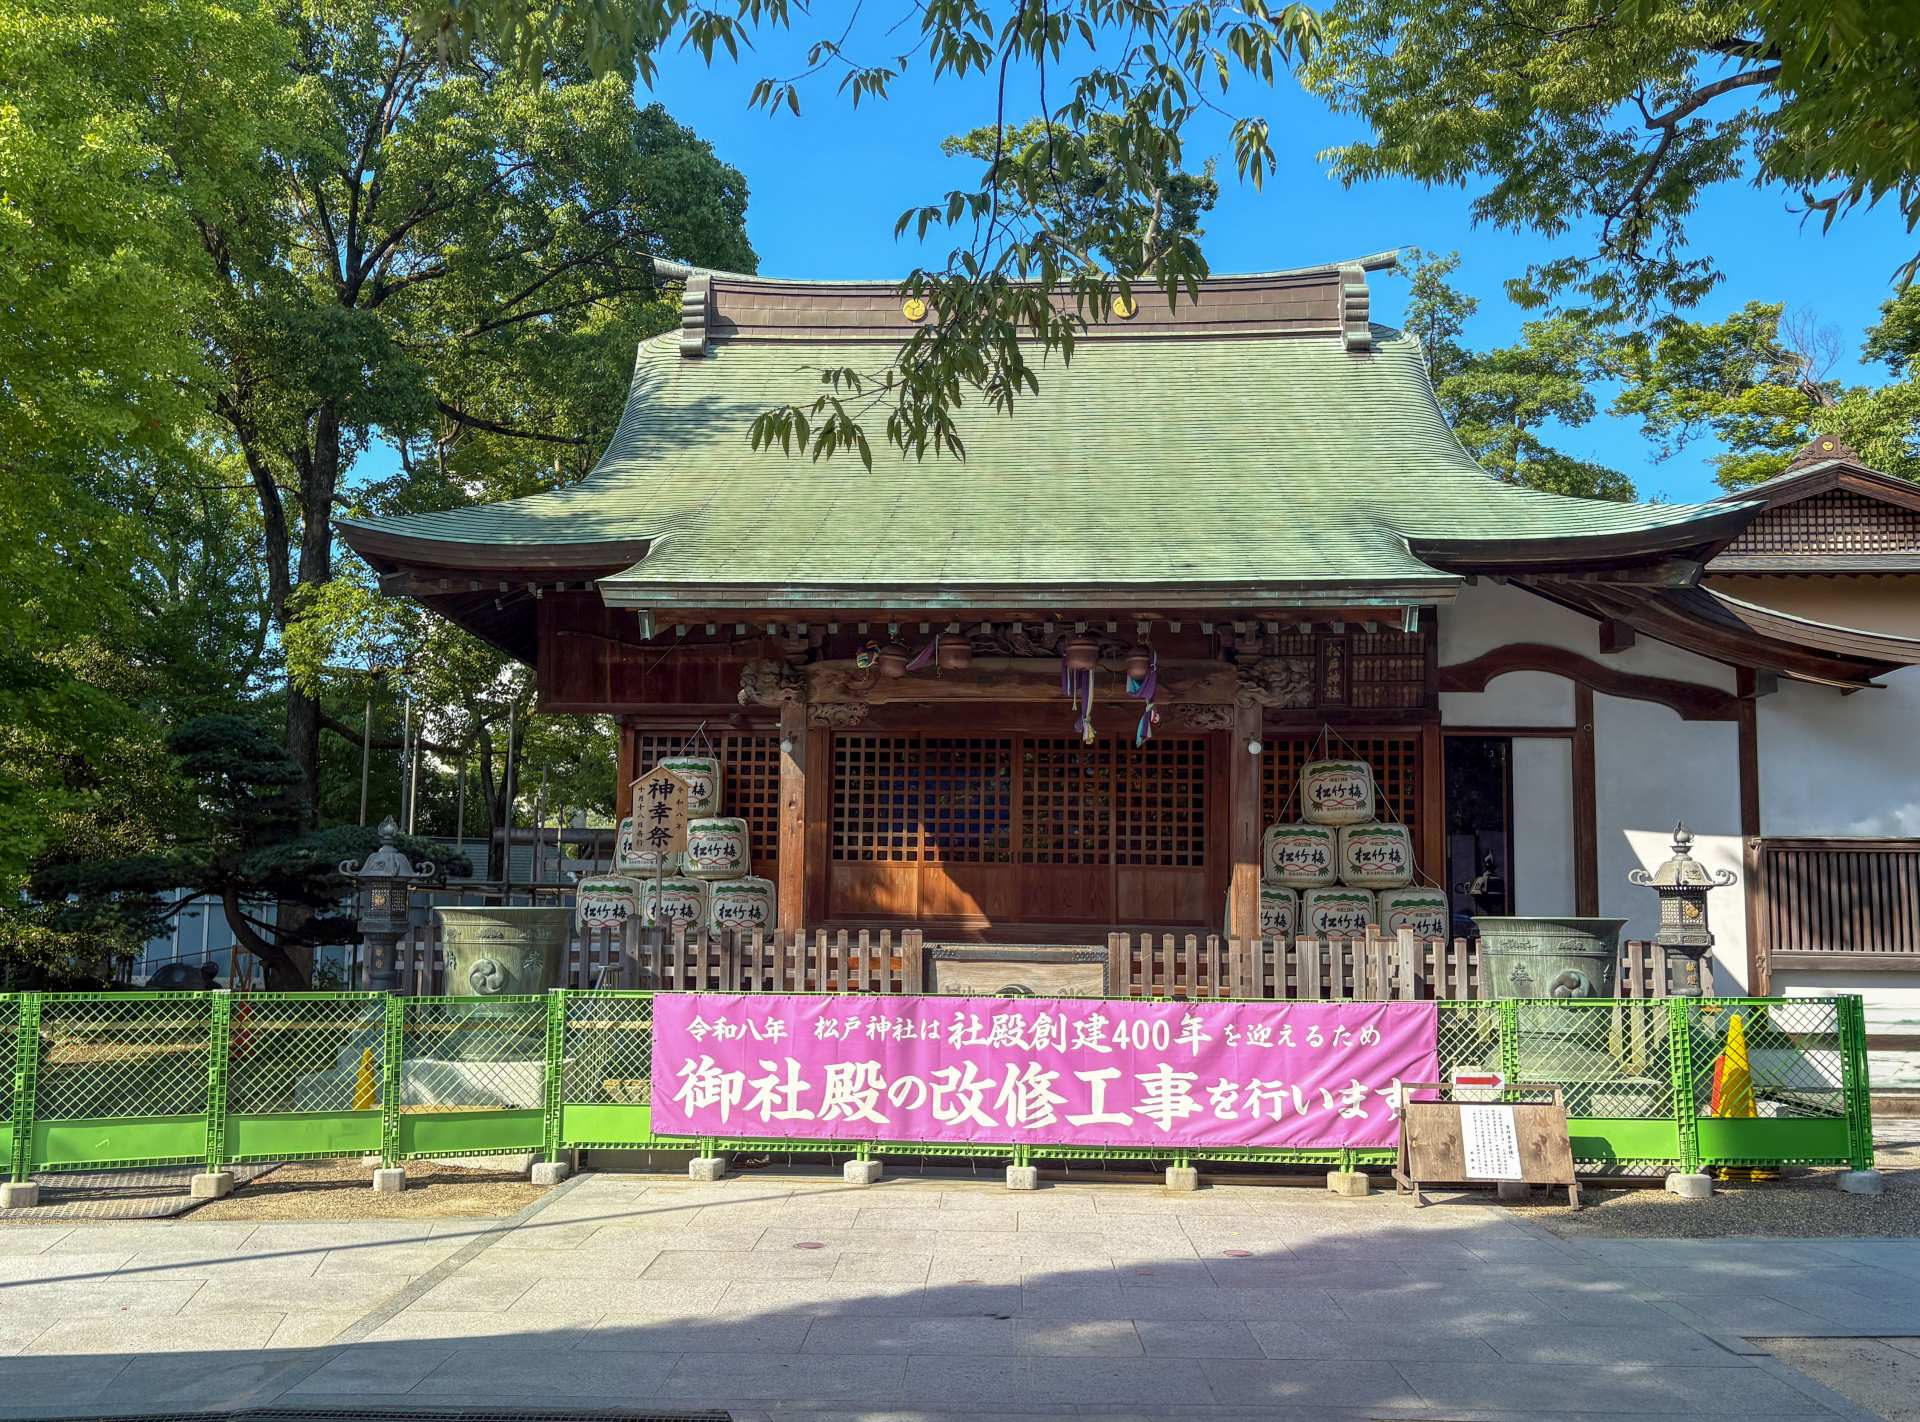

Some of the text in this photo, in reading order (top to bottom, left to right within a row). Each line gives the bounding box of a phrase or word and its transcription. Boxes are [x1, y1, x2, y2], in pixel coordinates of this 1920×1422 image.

[1315, 783, 1362, 800] 松竹梅
[646, 777, 675, 848] 神幸祭
[693, 841, 737, 858] 松竹梅
[1278, 848, 1326, 864] 松竹梅
[1354, 847, 1402, 864] 松竹梅
[584, 902, 627, 919] 松竹梅
[719, 904, 762, 920] 松竹梅
[1320, 912, 1366, 929] 松竹梅
[686, 1014, 788, 1045] 令和八年
